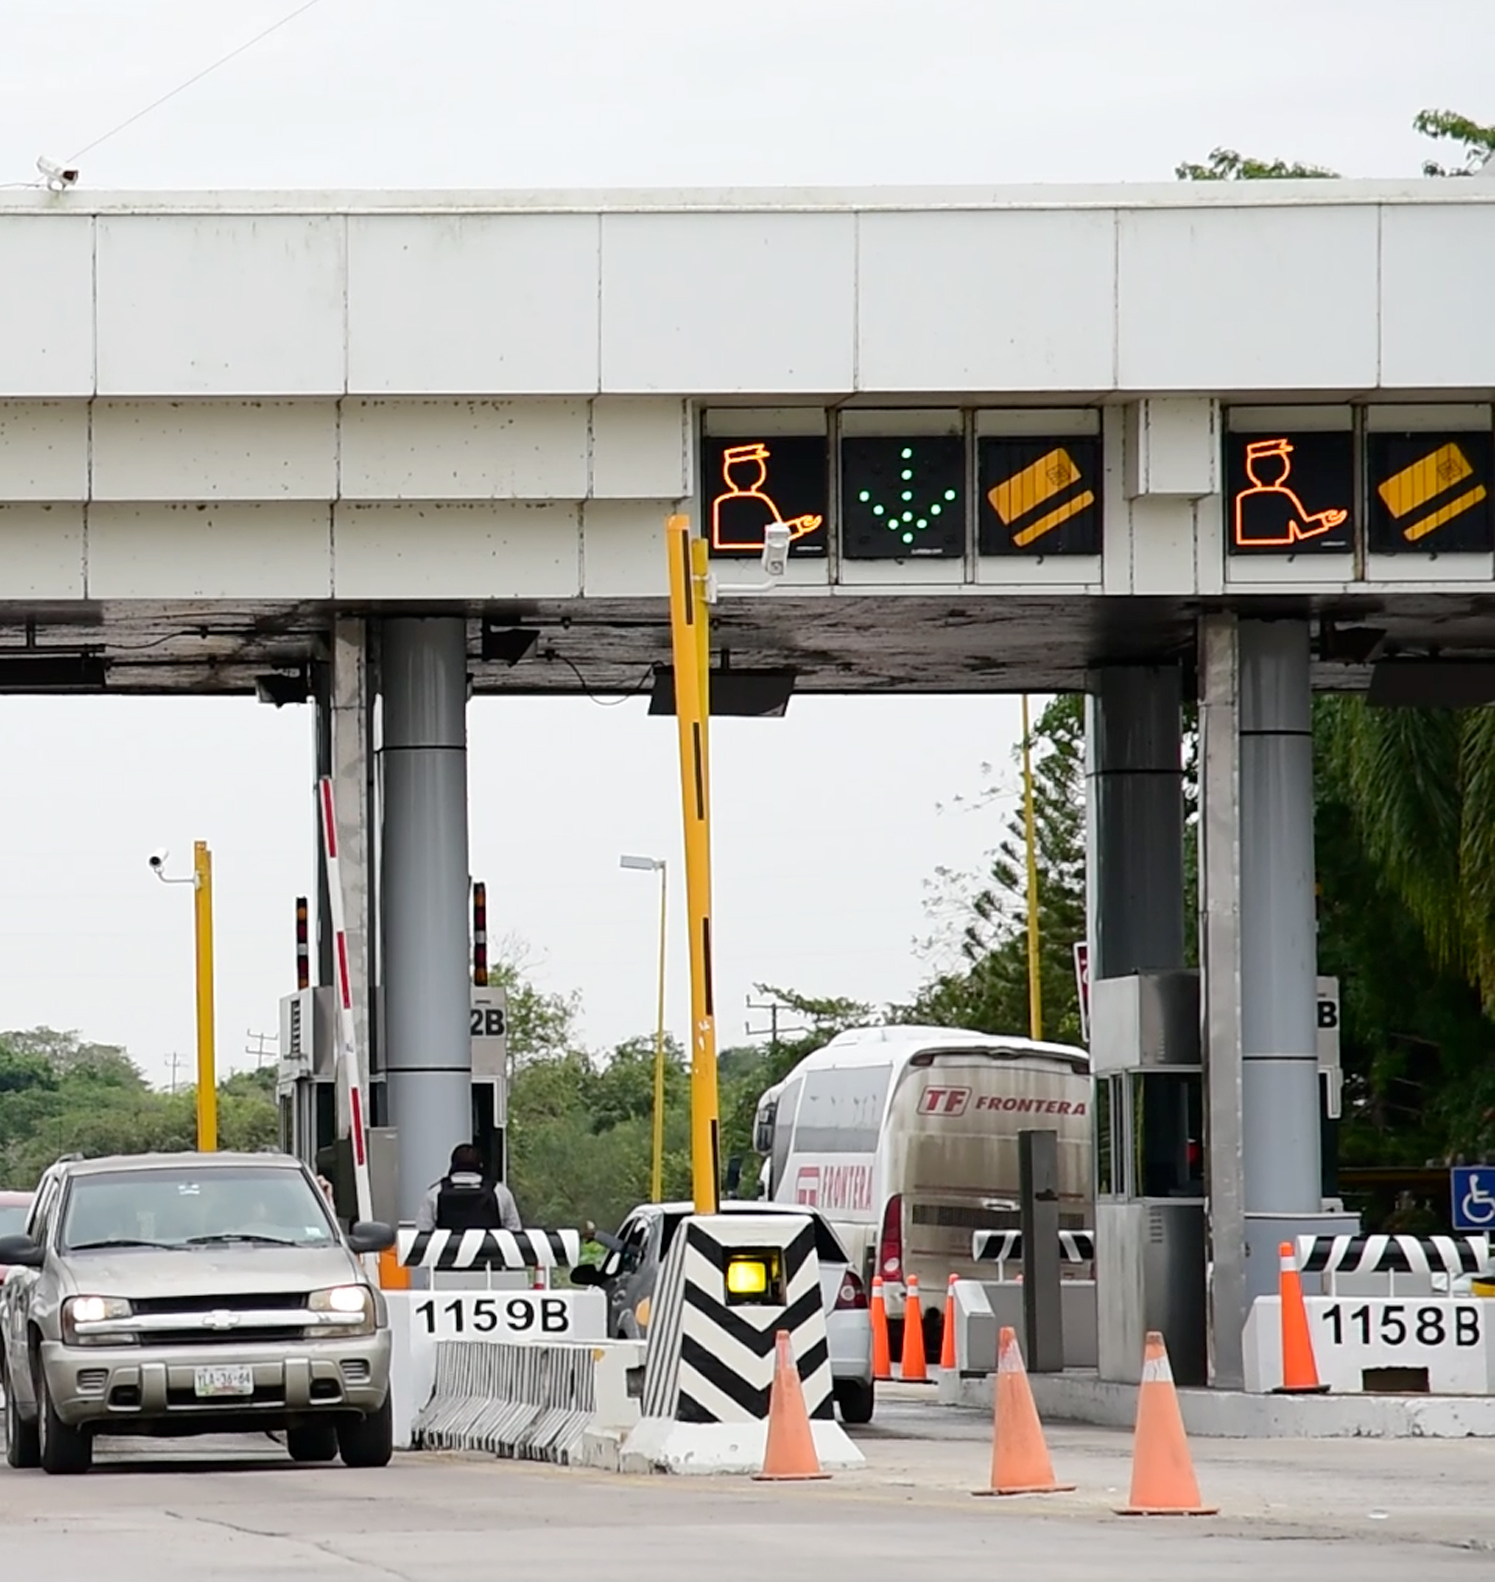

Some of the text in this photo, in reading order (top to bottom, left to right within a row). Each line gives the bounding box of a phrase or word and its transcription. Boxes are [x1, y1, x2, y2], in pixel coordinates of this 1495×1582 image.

[924, 1089, 1087, 1116] TF FRONTERA
[820, 1164, 874, 1211] FRONTERA
[415, 1298, 570, 1333] 1159B
[1322, 1303, 1481, 1346] 1158B
